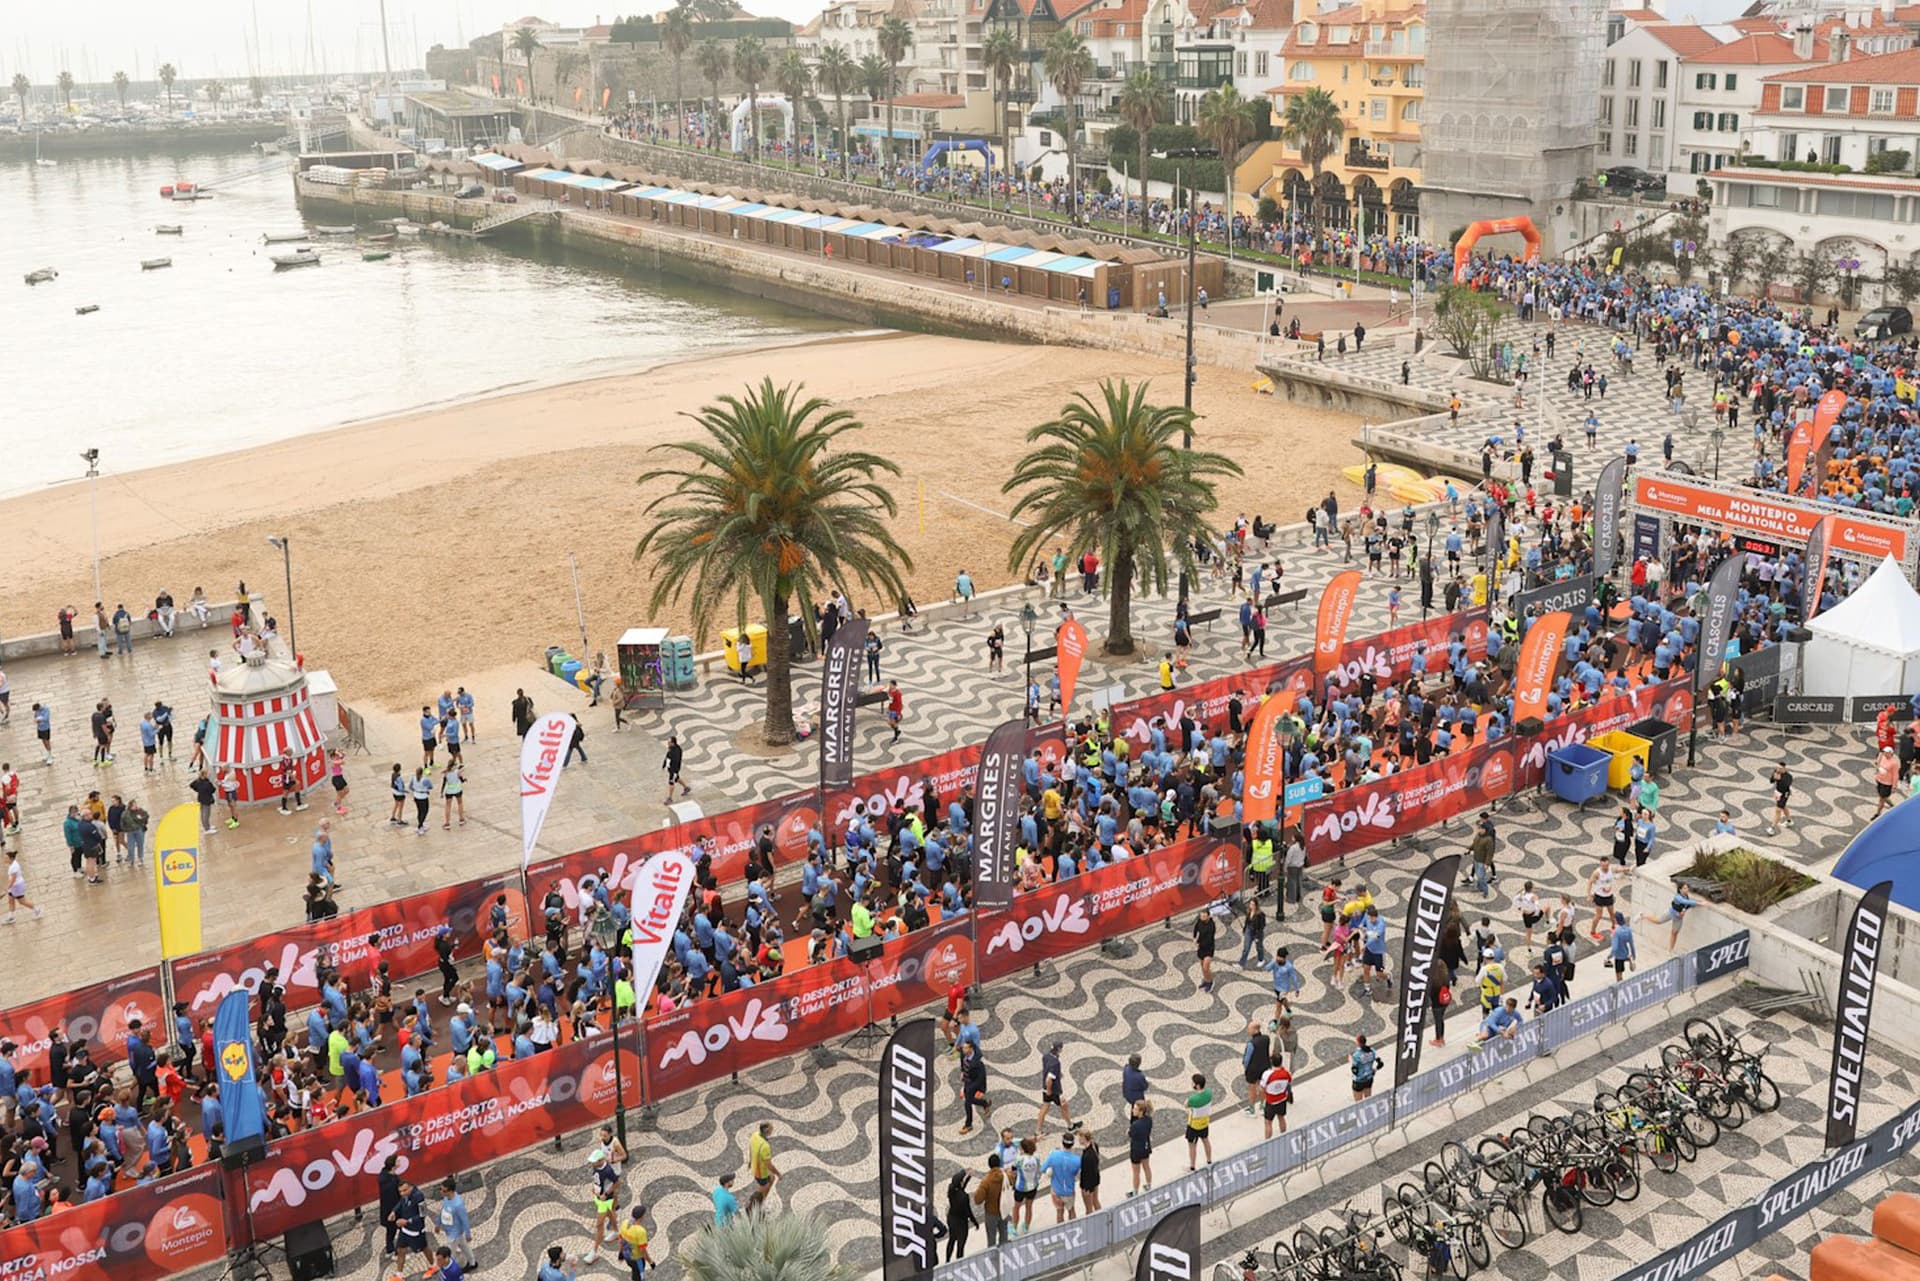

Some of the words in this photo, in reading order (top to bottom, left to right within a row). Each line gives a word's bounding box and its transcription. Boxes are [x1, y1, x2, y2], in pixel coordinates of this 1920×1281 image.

[1602, 493, 1613, 548] CASCAIS
[1697, 504, 1722, 518] MEIA
[1725, 511, 1783, 532] MARATONA
[1730, 500, 1797, 523] MONTEPIO
[1330, 588, 1349, 636] Montepio
[1524, 589, 1586, 619] CSCAIS
[1706, 594, 1726, 657] CASCAIS
[1533, 632, 1556, 685] Montepio
[825, 646, 845, 764] MARGRES
[1787, 703, 1834, 712] CASCAIS
[520, 719, 566, 797] Vitalis
[1288, 786, 1307, 800] SUB
[1308, 782, 1320, 794] 45
[1405, 779, 1442, 800] DESPORTO
[979, 752, 1000, 882] MARGRES
[1002, 810, 1014, 884] CERAMIC
[1008, 753, 1019, 798] TILES
[1310, 792, 1395, 842] MOVE
[723, 838, 757, 856] NOSSA
[632, 861, 683, 945] Vitalis
[1101, 899, 1121, 912] UMA
[1123, 889, 1153, 905] CAUSA
[1103, 877, 1150, 900] DESPORTO
[986, 893, 1090, 955] MOVE
[342, 947, 368, 963] UMA
[379, 935, 409, 953] AUSA
[1402, 877, 1448, 1059] SPECIALIZED
[801, 1001, 825, 1017] UMA
[828, 988, 864, 1007] CAUSA
[802, 975, 860, 1004] DESPORTO
[660, 998, 789, 1070] MOVE
[1833, 907, 1881, 1126] SPECIALIZED
[410, 1123, 423, 1137] O
[425, 1098, 499, 1132] DESPORTO
[425, 1129, 455, 1147] UMA
[460, 1111, 504, 1135] CAUSA
[507, 1095, 552, 1121] NOSSA
[247, 1127, 409, 1214] MOVE
[891, 1043, 926, 1269] SPECIALIZED
[1757, 1143, 1867, 1230] SPECIALIZED
[0, 1254, 37, 1275] RTO
[50, 1247, 107, 1276] NOSSA
[161, 1228, 213, 1252] Montepio
